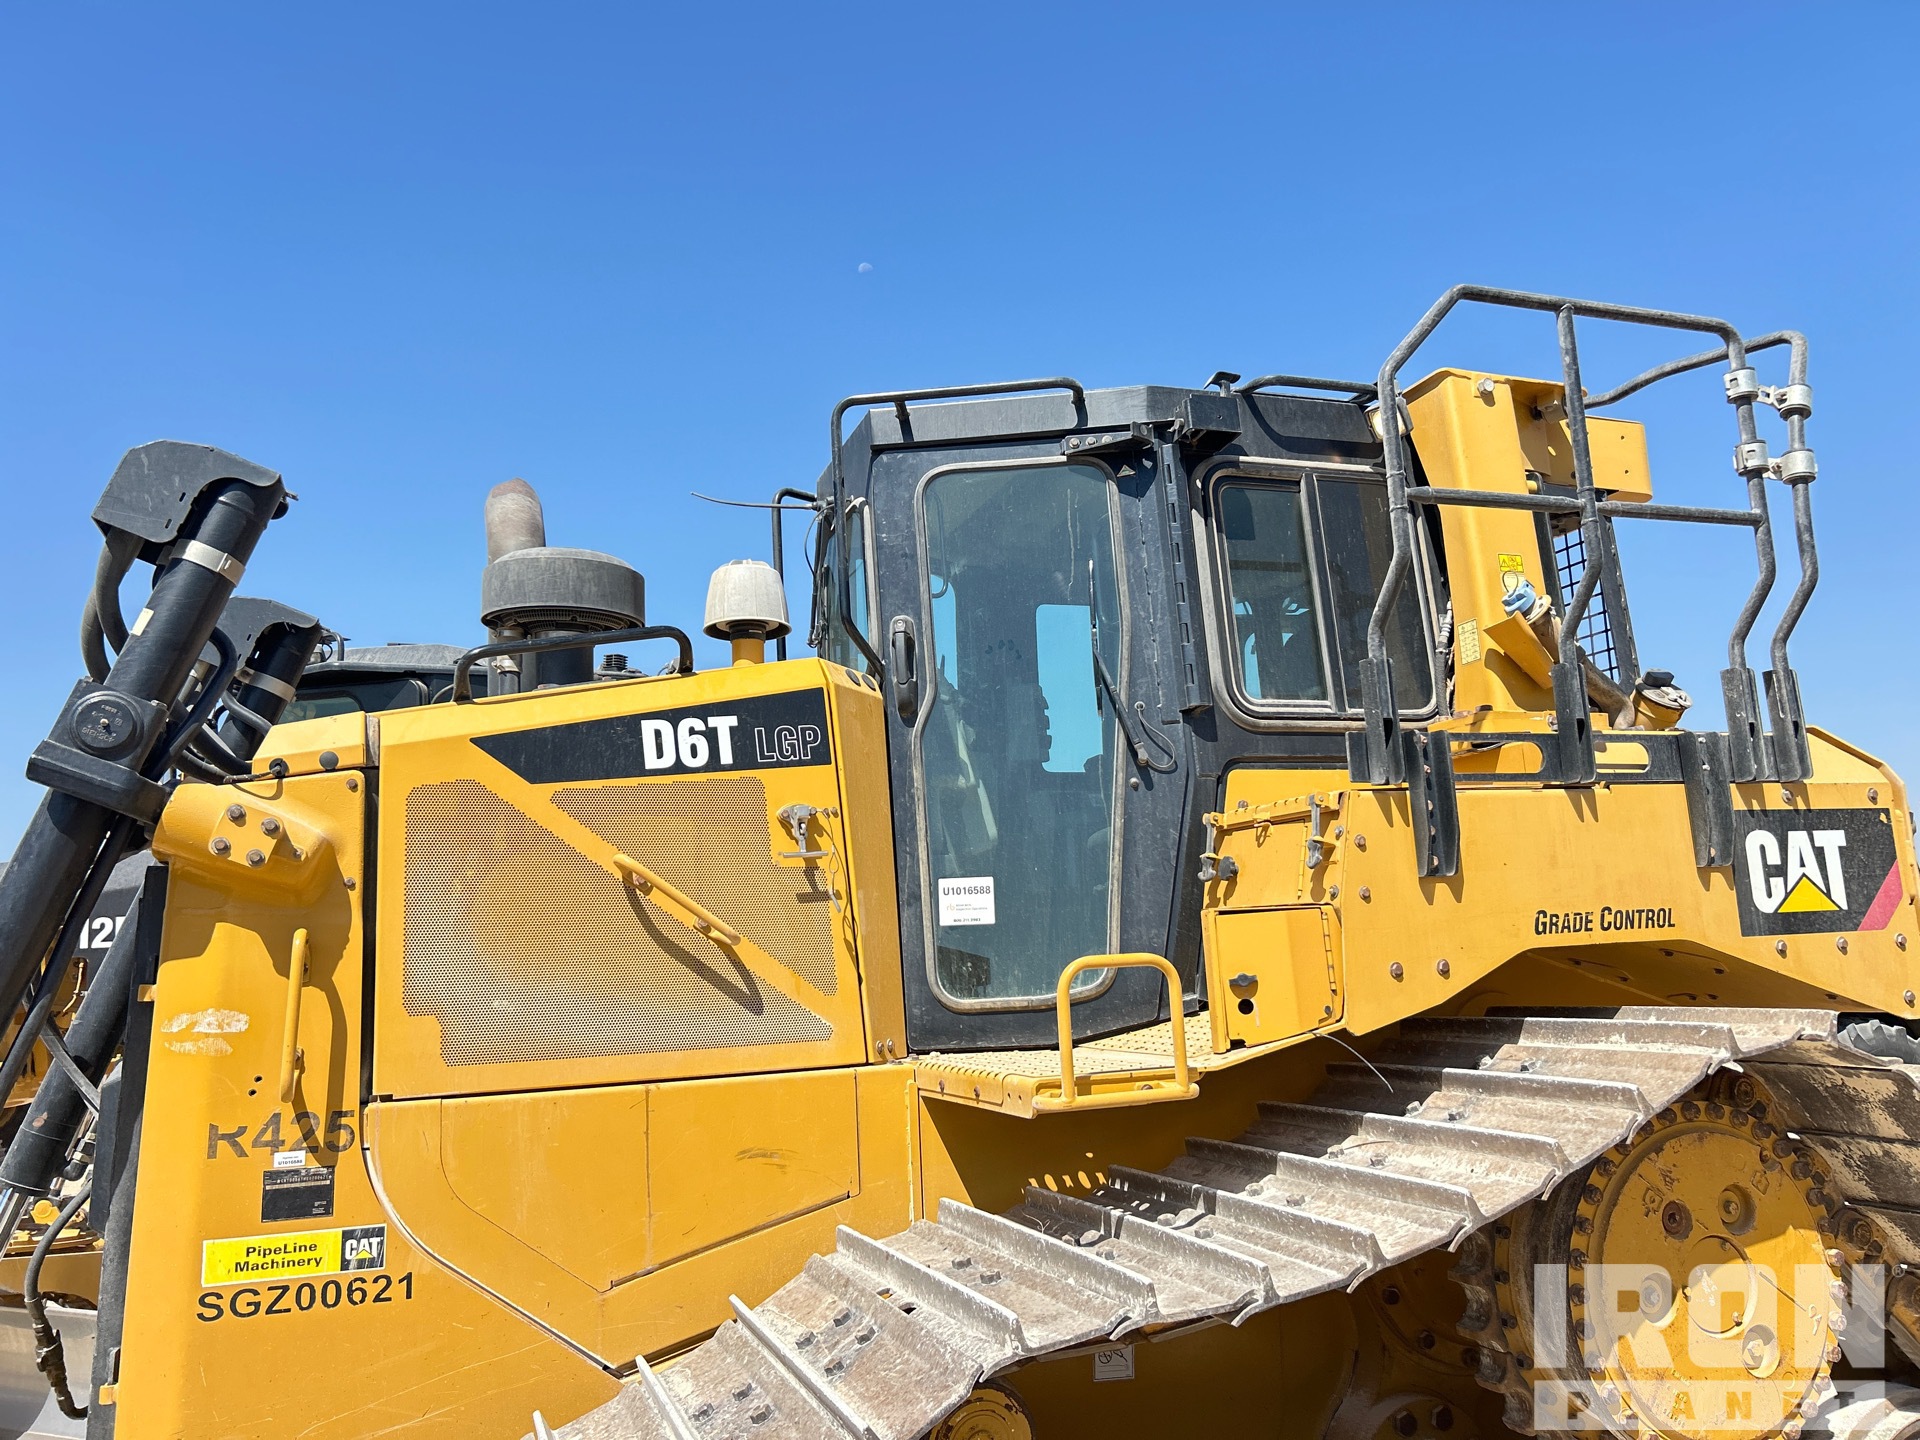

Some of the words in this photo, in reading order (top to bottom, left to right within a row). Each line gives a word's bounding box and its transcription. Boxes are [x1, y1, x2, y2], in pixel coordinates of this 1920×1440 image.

[641, 715, 739, 770] D6T
[755, 725, 821, 763] LGP
[1745, 829, 1849, 914] CAT
[943, 886, 991, 896] U1016588
[1534, 909, 1594, 936] GRADE
[1600, 906, 1675, 931] CONTROL
[246, 1242, 318, 1259] PipeLine
[345, 1237, 381, 1260] CAT
[234, 1256, 323, 1273] Machinery
[196, 1271, 413, 1323] SGZ00621
